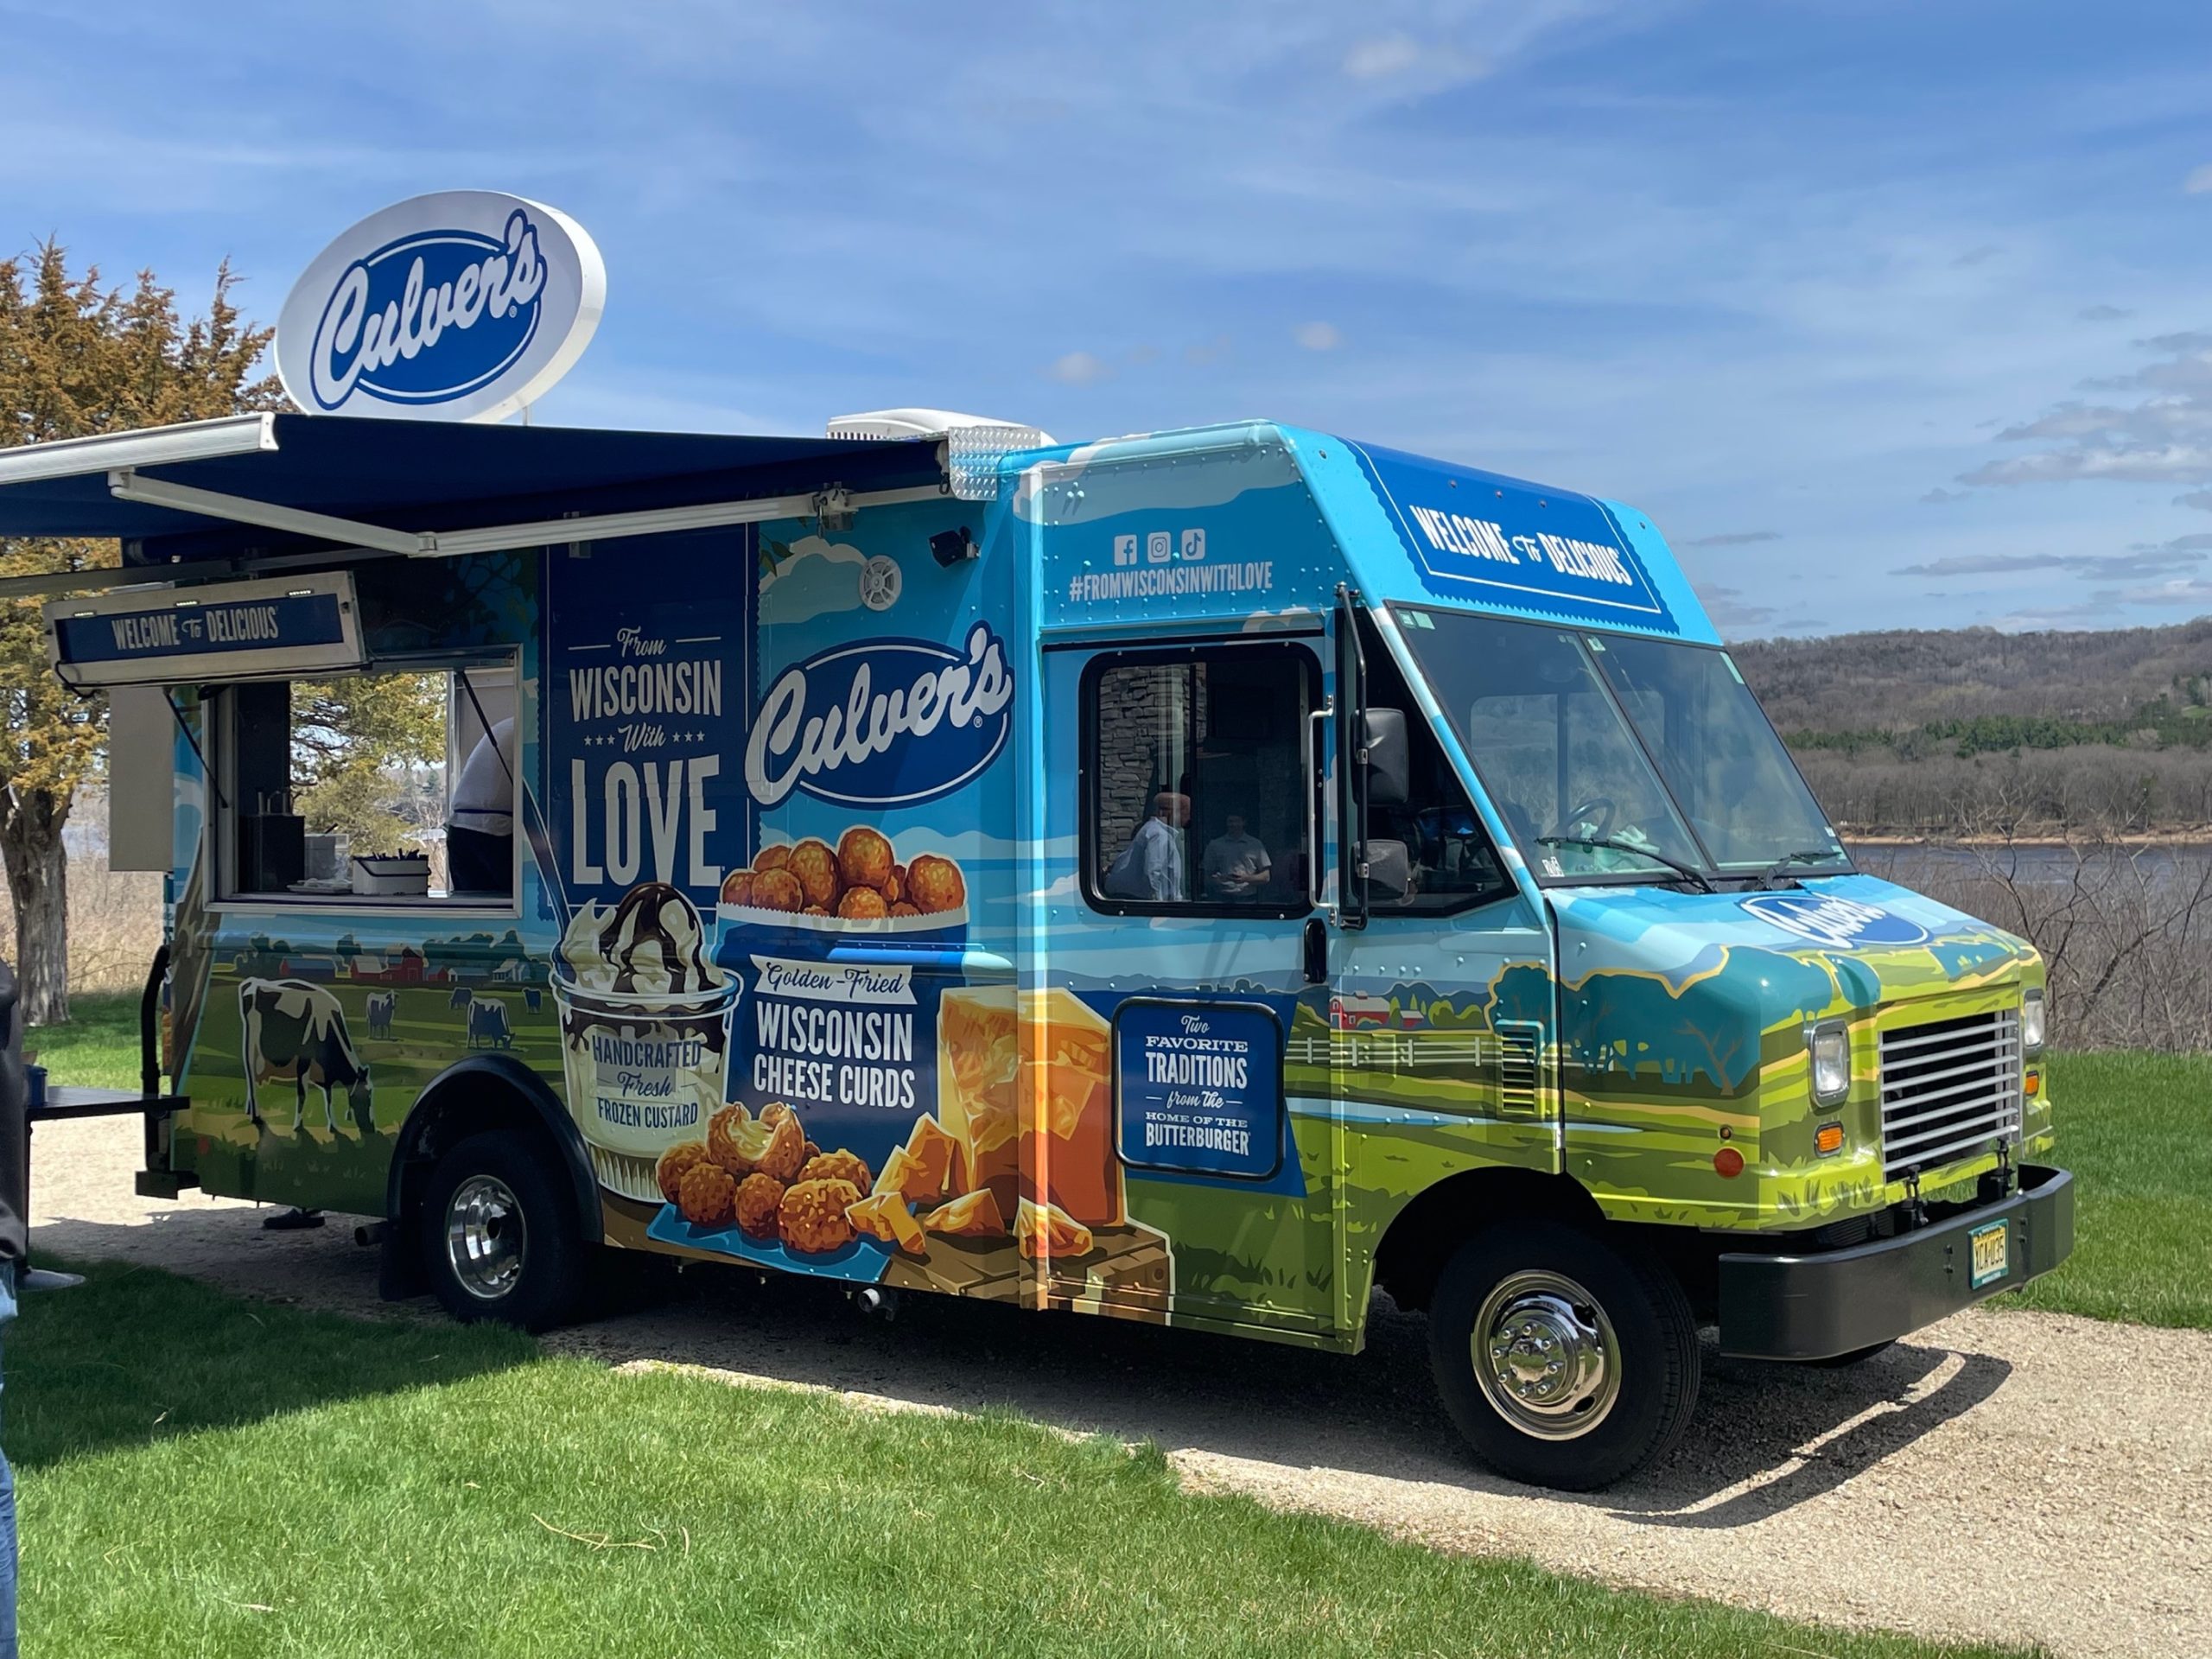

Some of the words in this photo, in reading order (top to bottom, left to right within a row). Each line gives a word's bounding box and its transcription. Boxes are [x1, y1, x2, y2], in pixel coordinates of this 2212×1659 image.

[312, 215, 543, 404] Culver's
[1409, 505, 1521, 565] WELCOME
[1536, 532, 1633, 587] DELICIOUS
[1069, 561, 1274, 602] #FROMWISCONSINWITHLOVE
[111, 613, 181, 651] WELCOME
[206, 607, 279, 643] DELICIOUS
[616, 625, 667, 658] From
[569, 659, 721, 722] WISCONSIN
[744, 626, 1013, 805] Culver's
[617, 722, 667, 753] With
[571, 753, 721, 887] LOVE
[756, 1001, 913, 1062] WISCONSIN
[1180, 1014, 1211, 1034] Two
[592, 1034, 702, 1069] HANDCRAFTED
[1145, 1035, 1249, 1053] FAVORITE
[617, 1071, 673, 1097] Fresh
[753, 1053, 834, 1103] CHEESE
[839, 1065, 916, 1109] CURDS
[1145, 1052, 1248, 1090] TRADITIONS
[597, 1096, 641, 1128] FROZEN
[644, 1102, 699, 1128] CUSTARD
[1166, 1090, 1201, 1109] from
[1145, 1111, 1190, 1122] HOME
[1192, 1116, 1213, 1125] OF
[1215, 1117, 1249, 1128] THE
[1145, 1122, 1250, 1157] BUTTERBURGER
